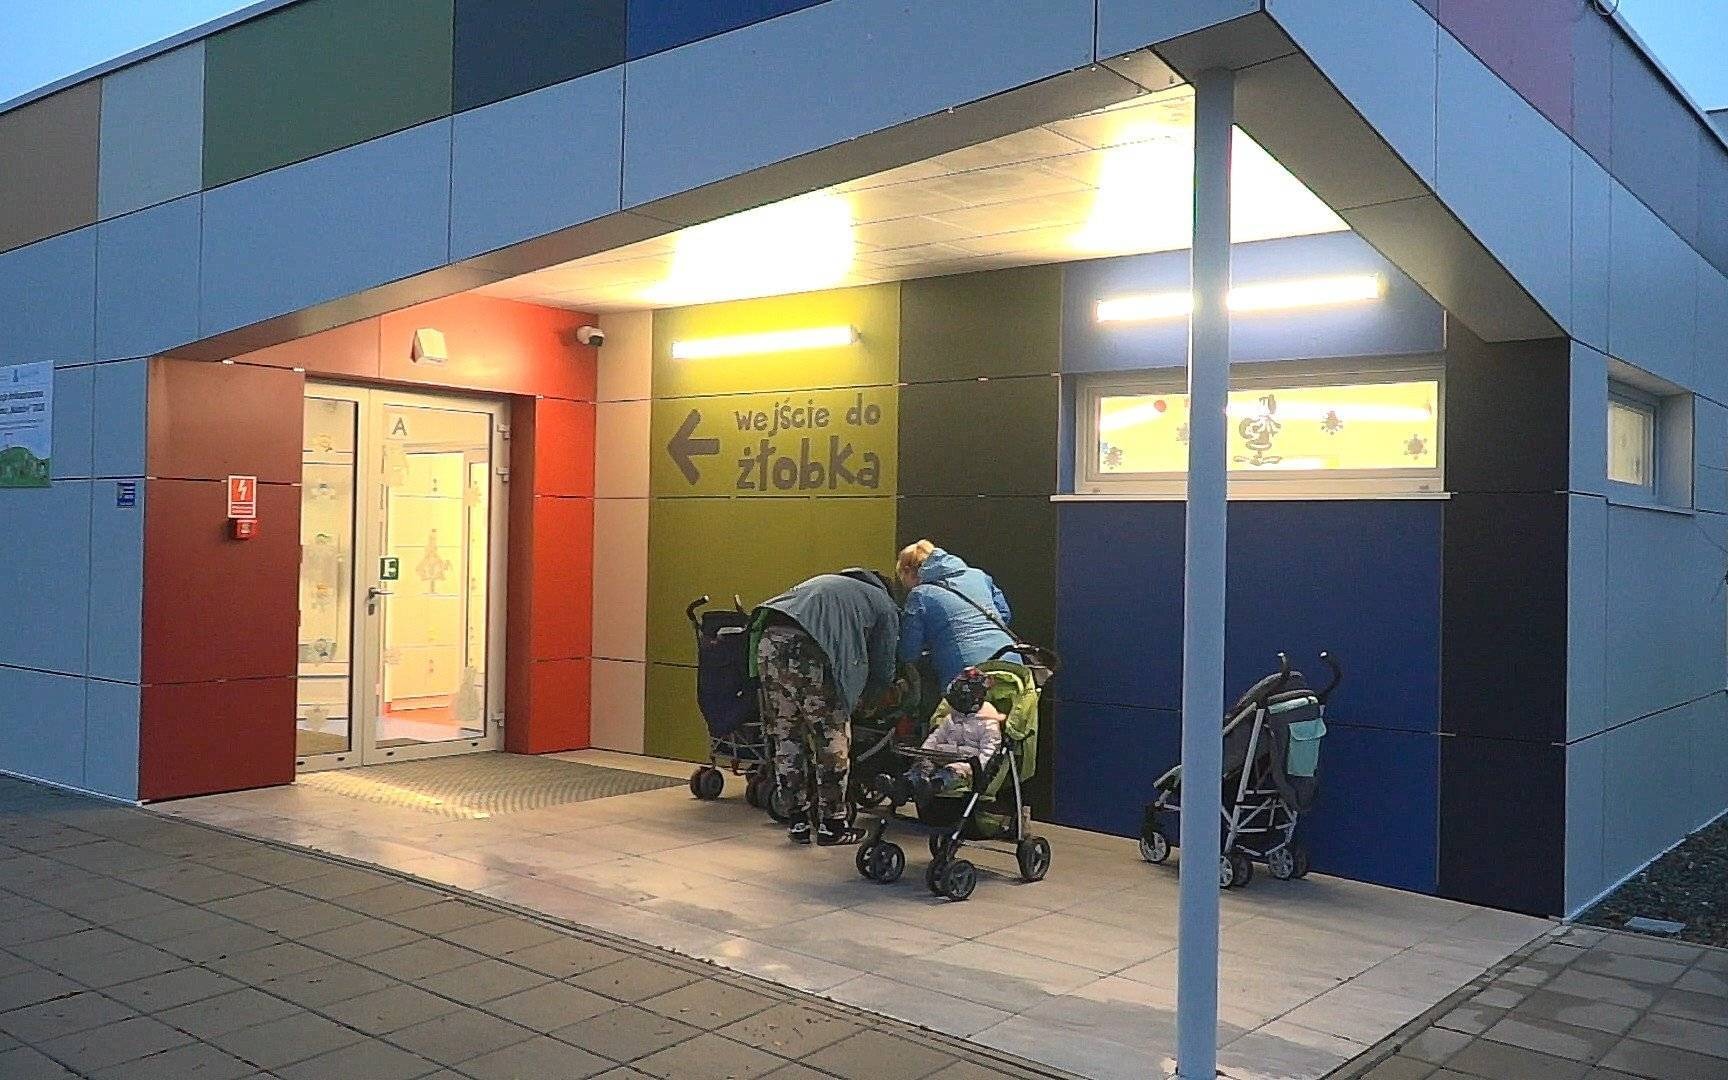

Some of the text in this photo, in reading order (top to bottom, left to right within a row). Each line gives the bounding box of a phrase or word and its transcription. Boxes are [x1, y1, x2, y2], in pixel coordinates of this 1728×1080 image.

[391, 416, 408, 436] A
[734, 392, 881, 437] wejście do
